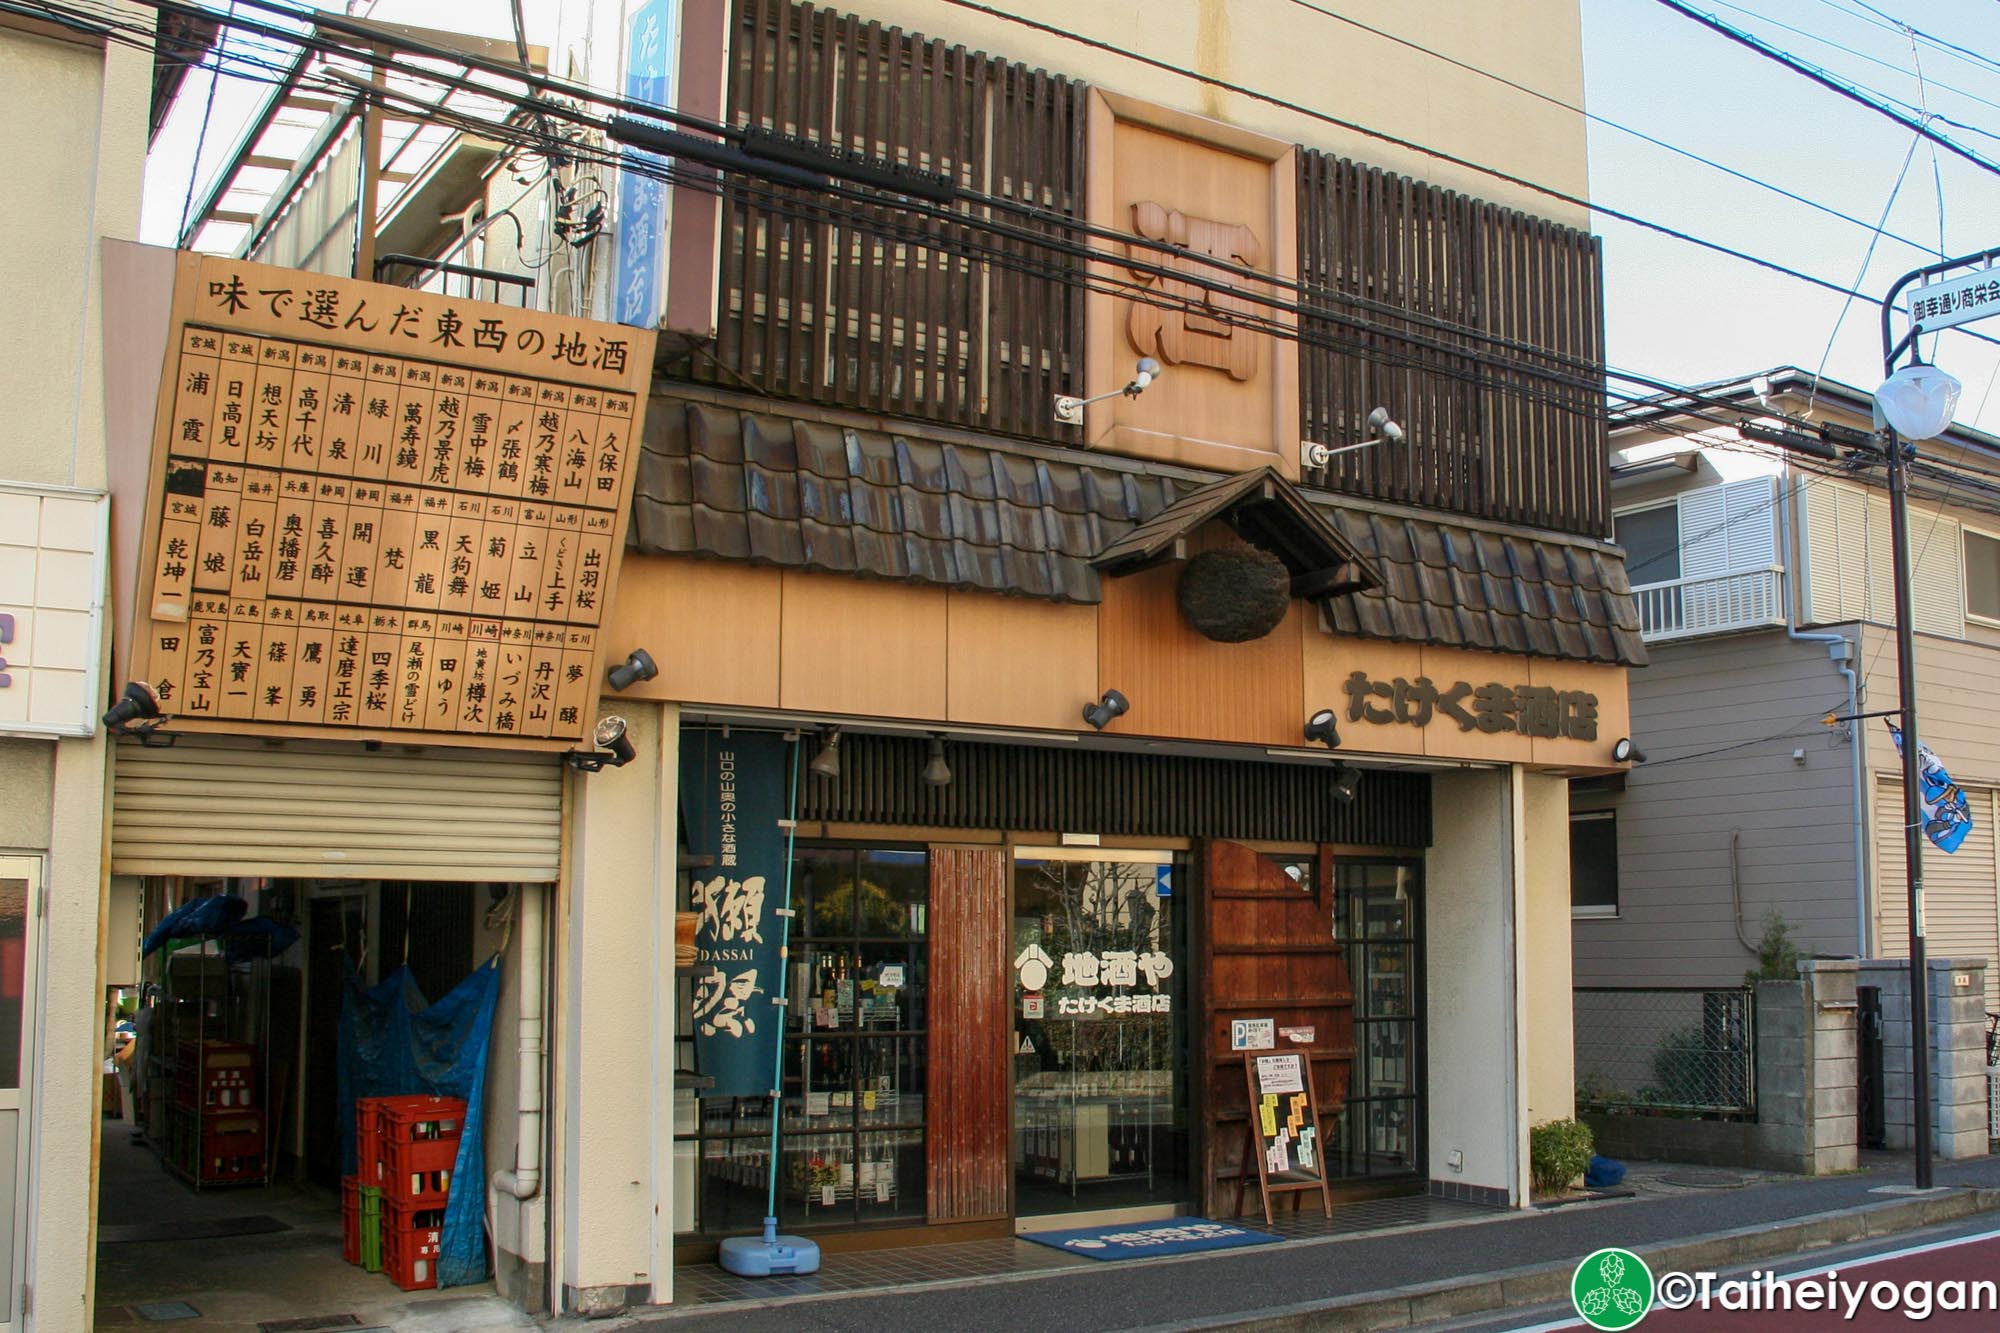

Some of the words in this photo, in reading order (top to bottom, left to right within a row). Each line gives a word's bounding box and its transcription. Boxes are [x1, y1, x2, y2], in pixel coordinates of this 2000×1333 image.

[209, 274, 628, 375] 味で選んだ東西の地酒
[1913, 280, 2000, 321] 御幸通り商栄会
[182, 372, 210, 443] 浦霞
[219, 381, 243, 447] 日高見
[255, 383, 282, 451] 想天坊
[292, 387, 318, 456] 高千代
[328, 392, 355, 460] 清泉
[362, 398, 389, 464] 緑川
[428, 396, 460, 484] 越乃景虎
[464, 413, 492, 478] 雪中梅
[528, 411, 559, 496] 越乃寒梅
[564, 429, 588, 489] 八海山
[597, 432, 620, 492] 久保田
[161, 537, 189, 598] 乾坤一
[203, 505, 231, 574] 藤娘
[240, 518, 265, 583] 白岳仙
[275, 514, 303, 580] 奥播磨
[311, 517, 338, 584] 喜久酔
[345, 522, 373, 588] 開運
[384, 547, 404, 569] 梵
[414, 530, 440, 594] 黒龍
[448, 534, 473, 596] 天狗舞
[480, 537, 506, 599] 菊姫
[514, 542, 538, 602] 立山
[576, 549, 600, 609] 出羽桜
[156, 637, 180, 700] 田倉
[191, 624, 219, 712] 富乃宝山
[299, 642, 322, 708] 鷹勇
[333, 635, 360, 721] 達磨正宗
[366, 650, 392, 711] 四季桜
[401, 642, 424, 723] 尾瀬の雪どけ
[438, 658, 458, 716] 田ゆう
[496, 652, 522, 731] いづみ橋
[529, 661, 555, 721] 丹沢山
[1343, 670, 1598, 742] たけくま酒店
[720, 751, 737, 867] 山口の山奥の小さな酒蔵
[700, 949, 753, 961] DASSAI
[1062, 950, 1174, 987] 地酒や
[1058, 994, 1171, 1014] たけくま酒店
[1235, 1024, 1246, 1046] P
